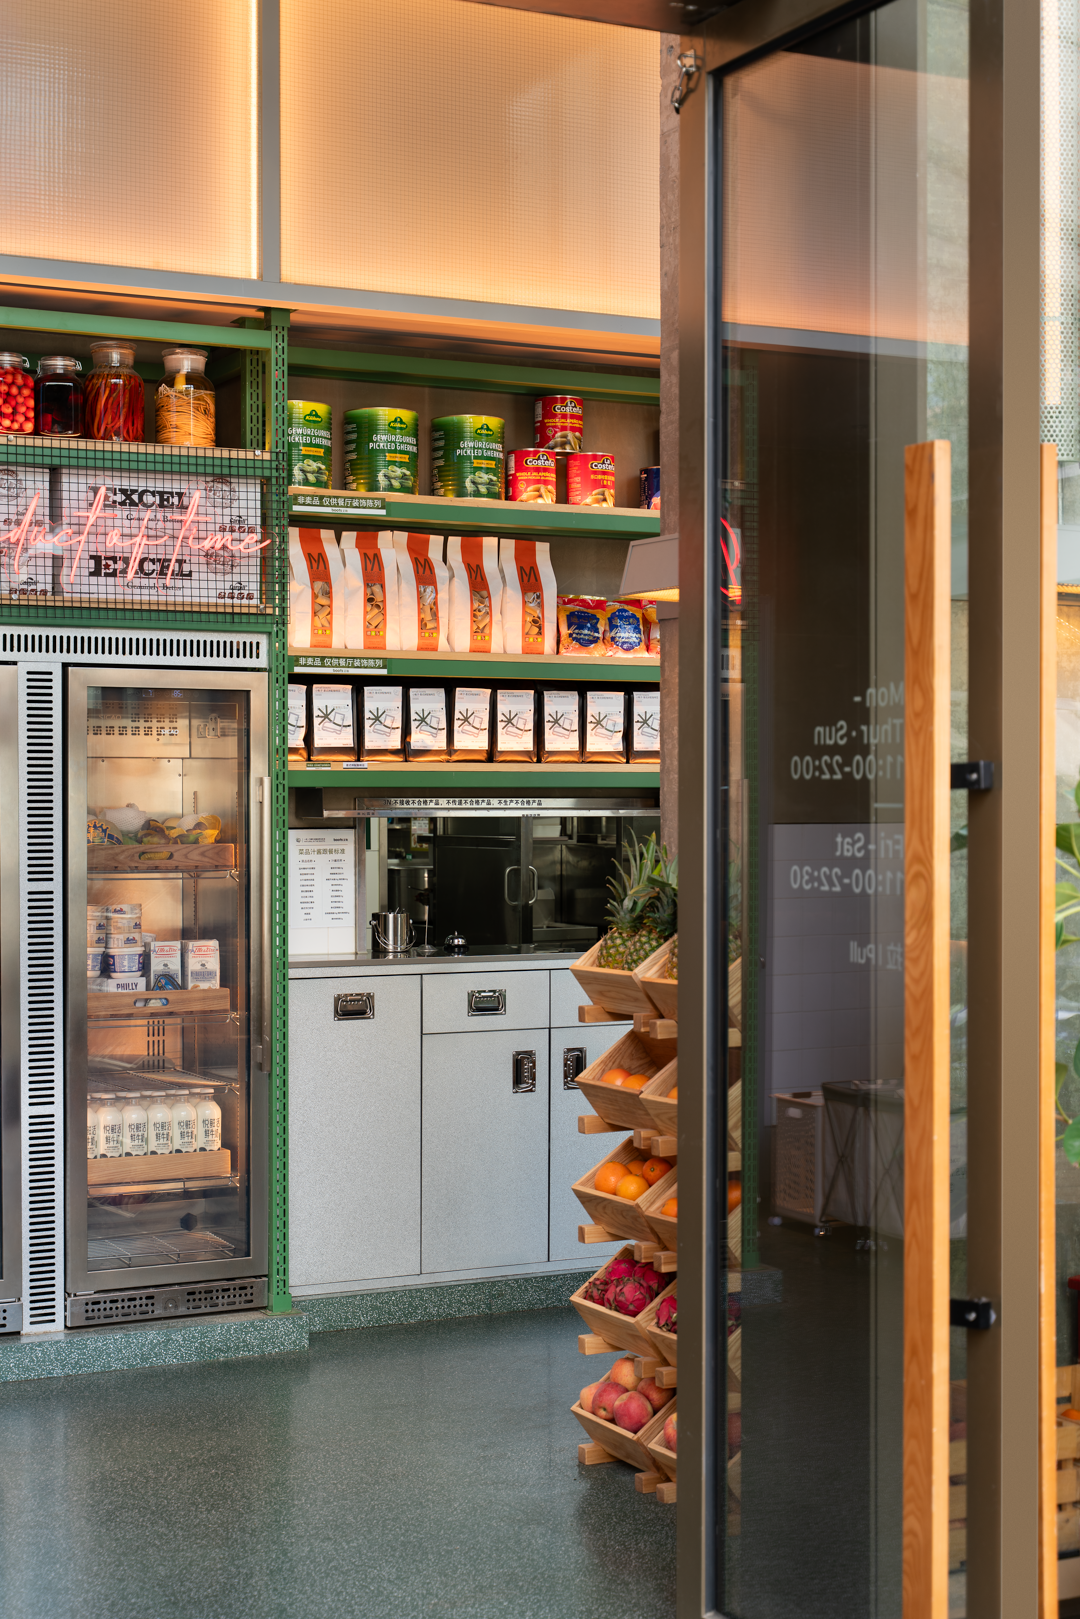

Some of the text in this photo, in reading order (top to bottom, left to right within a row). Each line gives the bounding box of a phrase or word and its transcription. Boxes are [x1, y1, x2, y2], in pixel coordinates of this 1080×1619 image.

[298, 496, 382, 508] 非卖品 仅供餐厅装饰陈列
[166, 490, 272, 586] time
[89, 554, 192, 578] EXCEL
[299, 657, 383, 668] 非卖品 仅供餐厅装饰陈列
[116, 982, 139, 991] PHILLY
